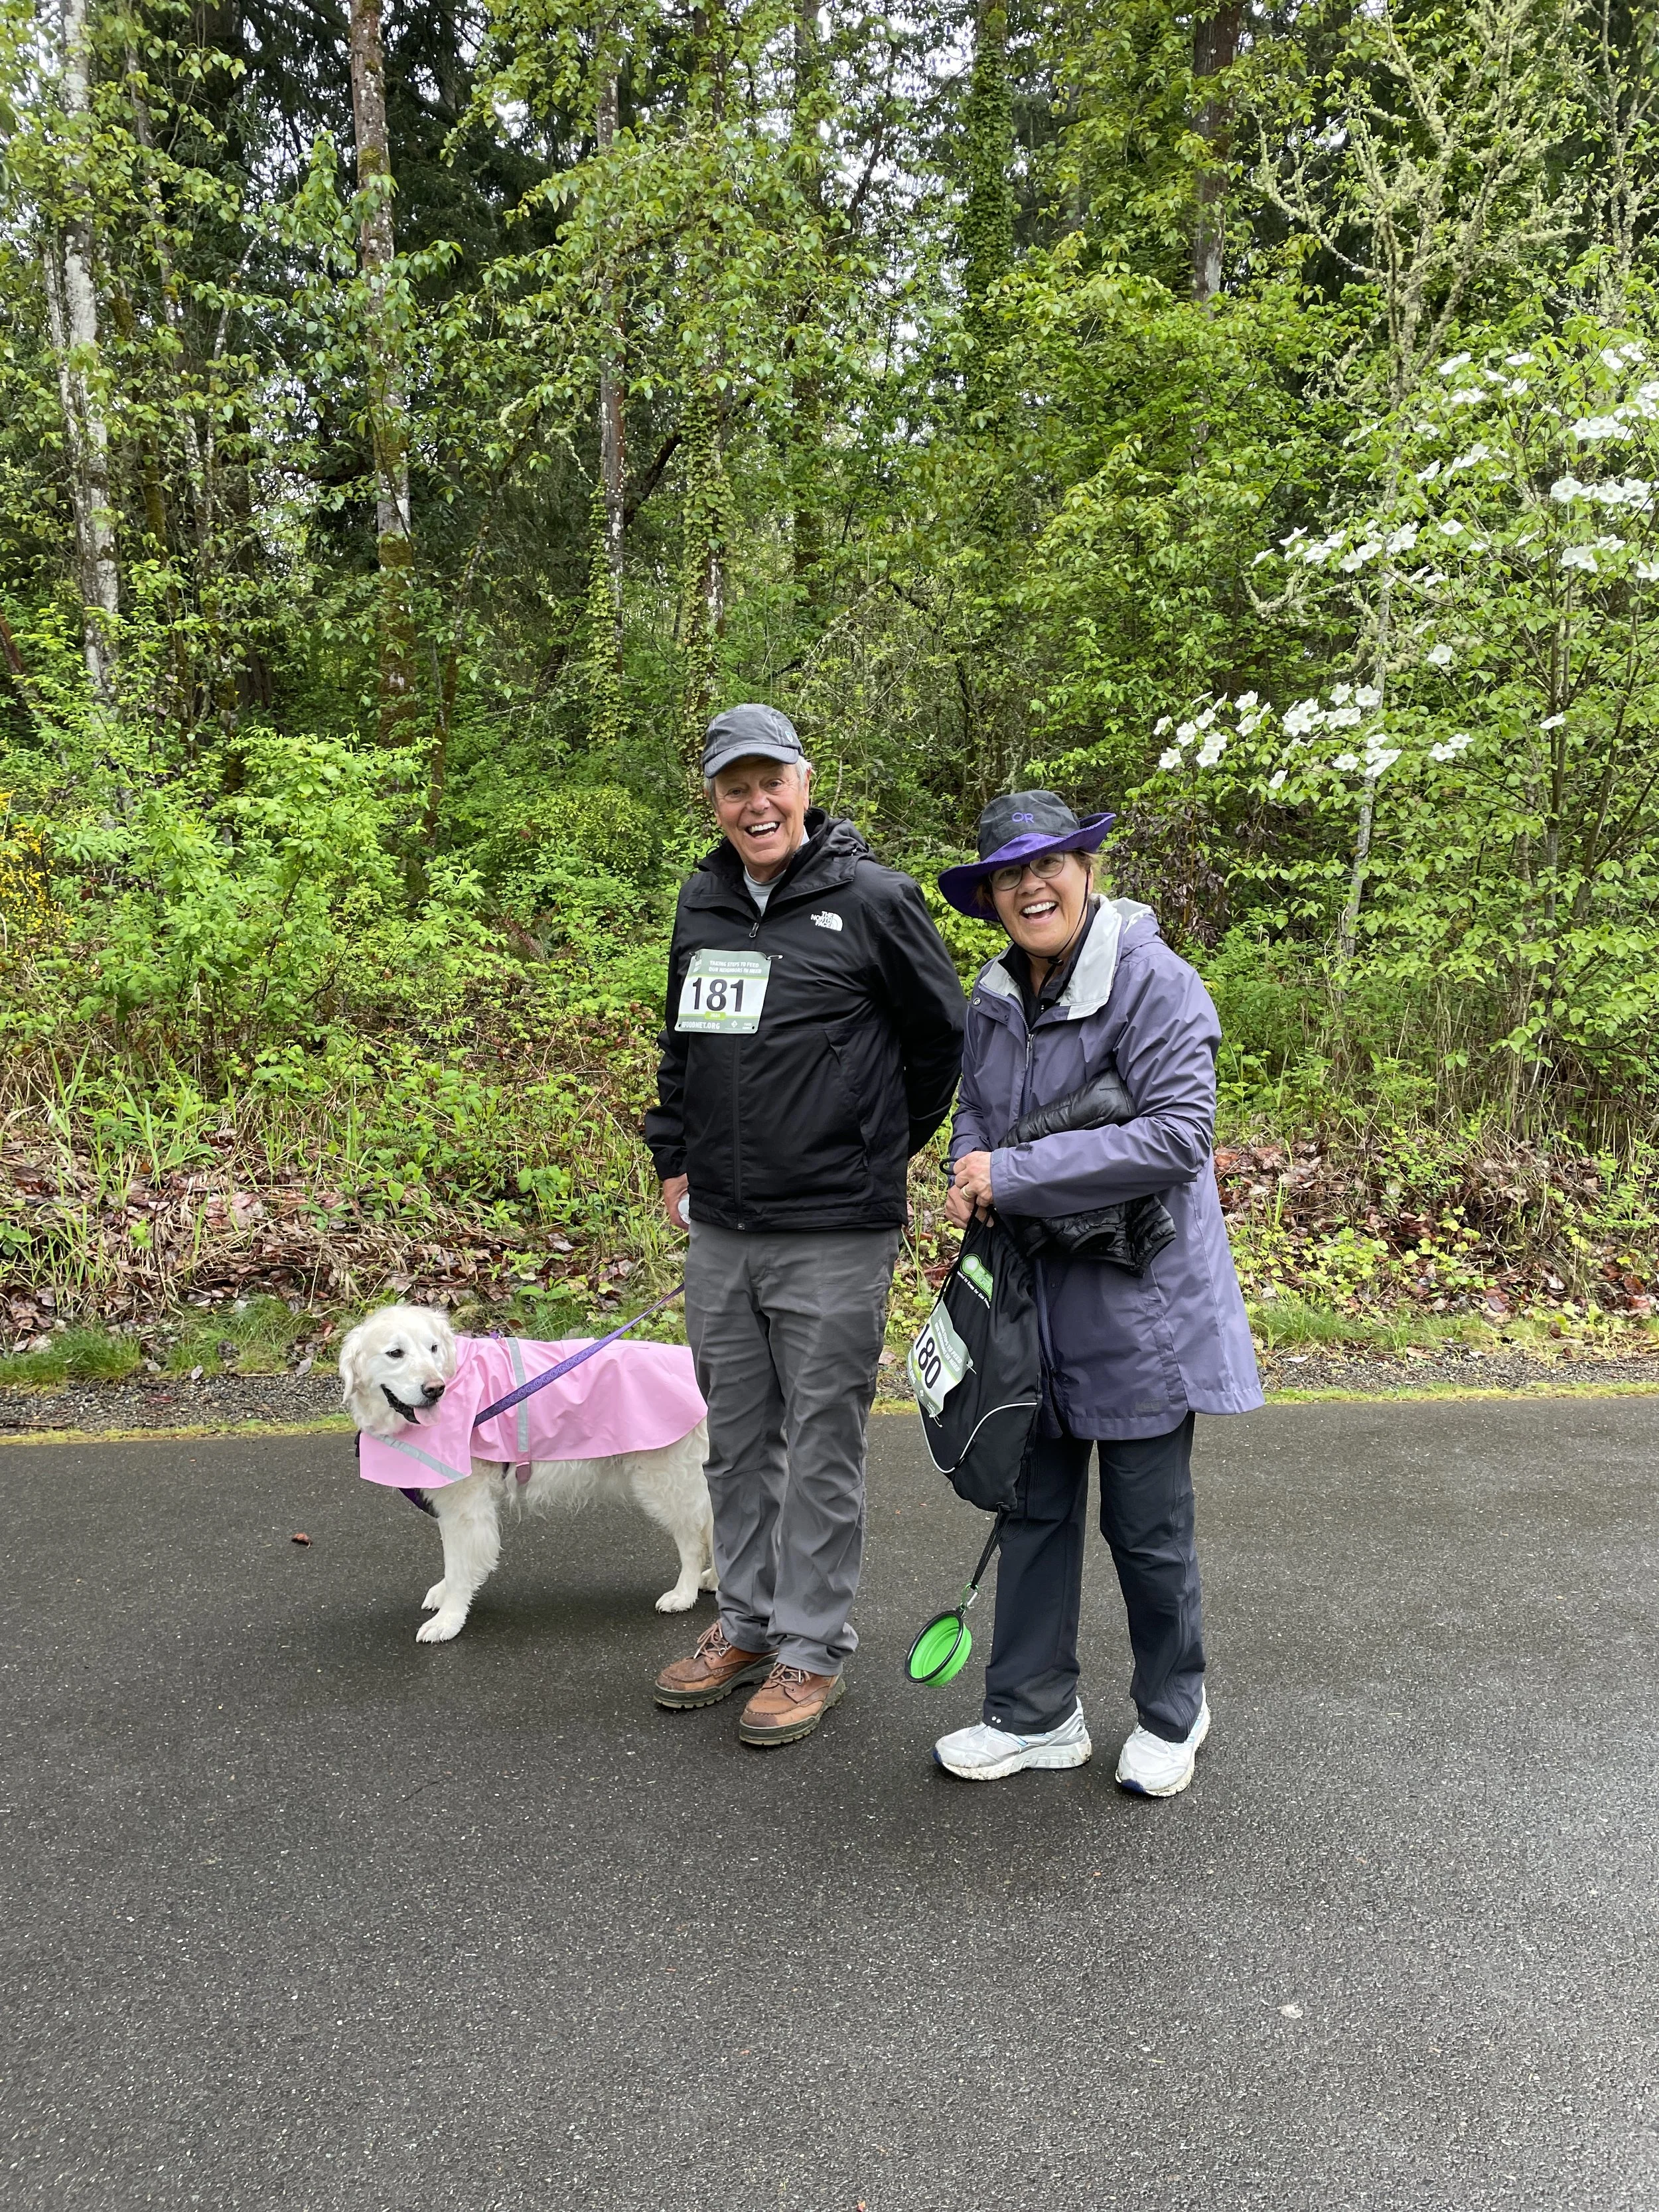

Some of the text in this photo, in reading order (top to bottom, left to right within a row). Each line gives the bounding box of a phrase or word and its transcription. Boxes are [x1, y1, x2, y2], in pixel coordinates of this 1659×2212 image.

[1011, 812, 1035, 823] OR
[811, 914, 833, 924] NORTH
[815, 920, 831, 928] FACE
[692, 977, 744, 1012] 181
[947, 1343, 954, 1352] TO
[951, 1349, 963, 1364] FEED
[949, 1357, 961, 1372] NEED
